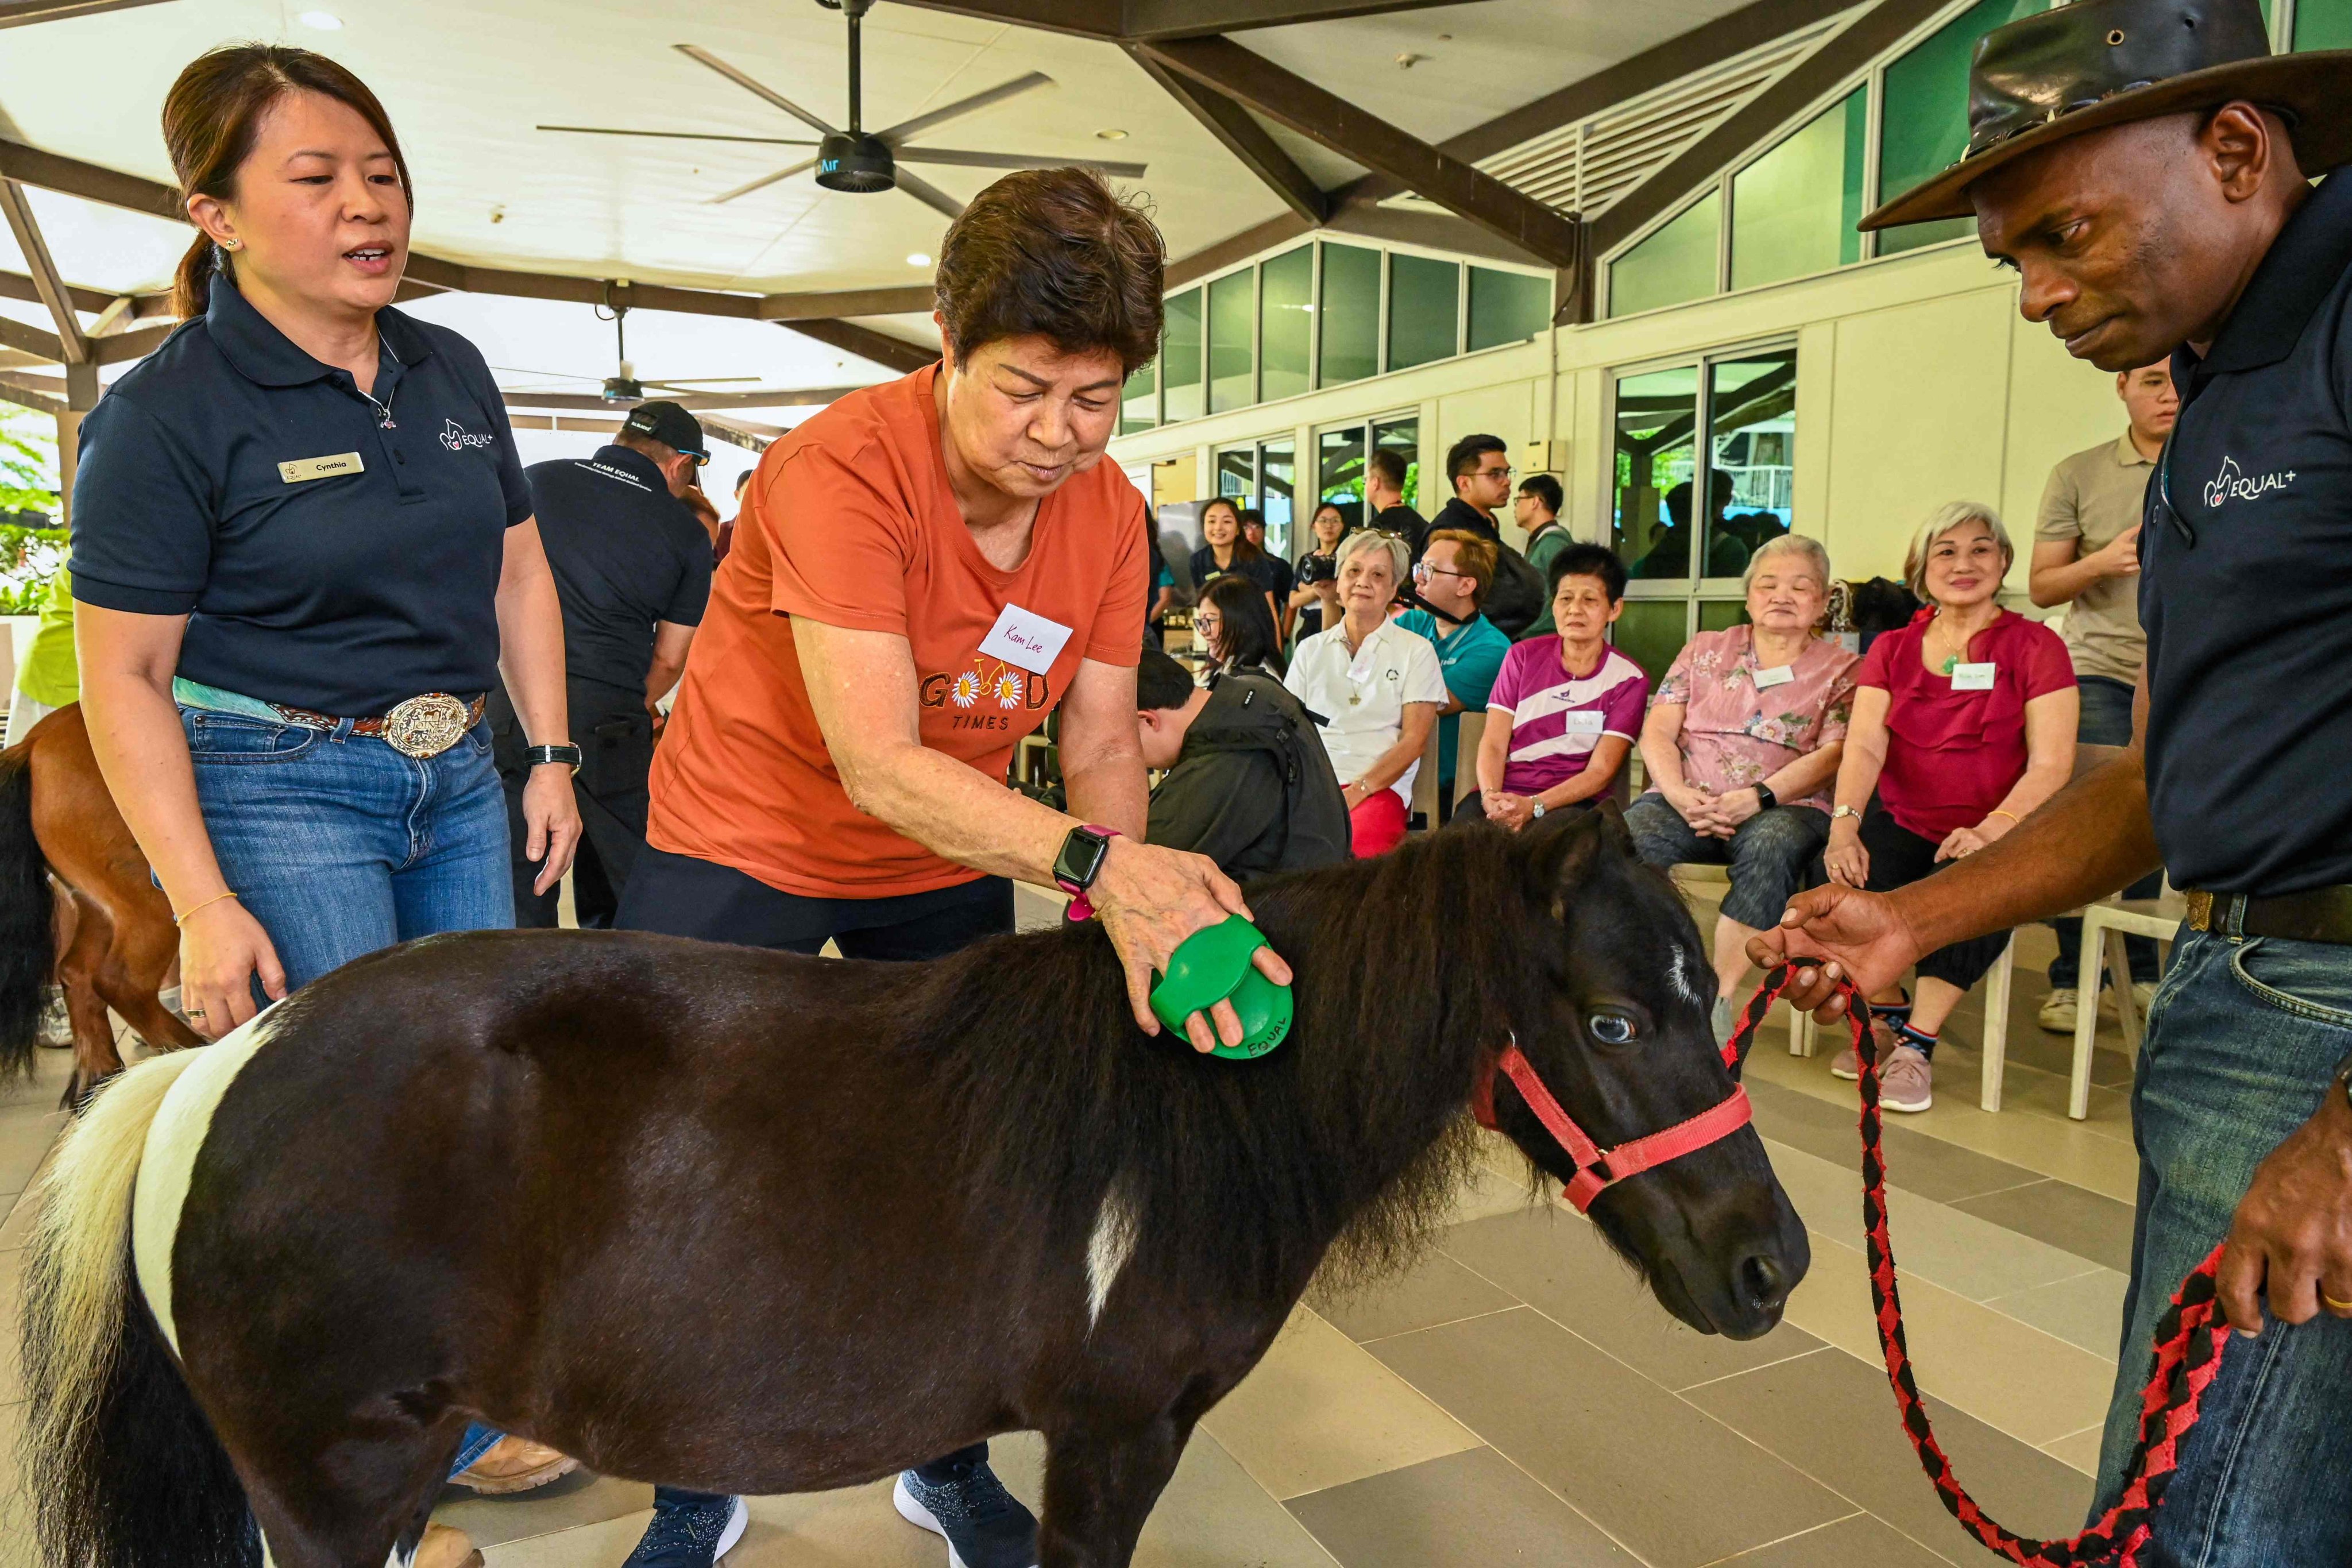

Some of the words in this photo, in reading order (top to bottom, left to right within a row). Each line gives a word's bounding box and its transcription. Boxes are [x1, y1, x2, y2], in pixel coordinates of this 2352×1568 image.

[821, 159, 839, 173] Air
[462, 434, 493, 447] EQUAL+
[316, 461, 346, 472] Cynthia
[593, 462, 614, 473] TEAM
[614, 469, 639, 482] EQUAL
[2230, 470, 2296, 500] EQUAL+
[1003, 624, 1025, 646] Kam
[1025, 636, 1042, 653] Lee
[953, 715, 1009, 731] TIMES
[1248, 1017, 1287, 1056] EQUAL
